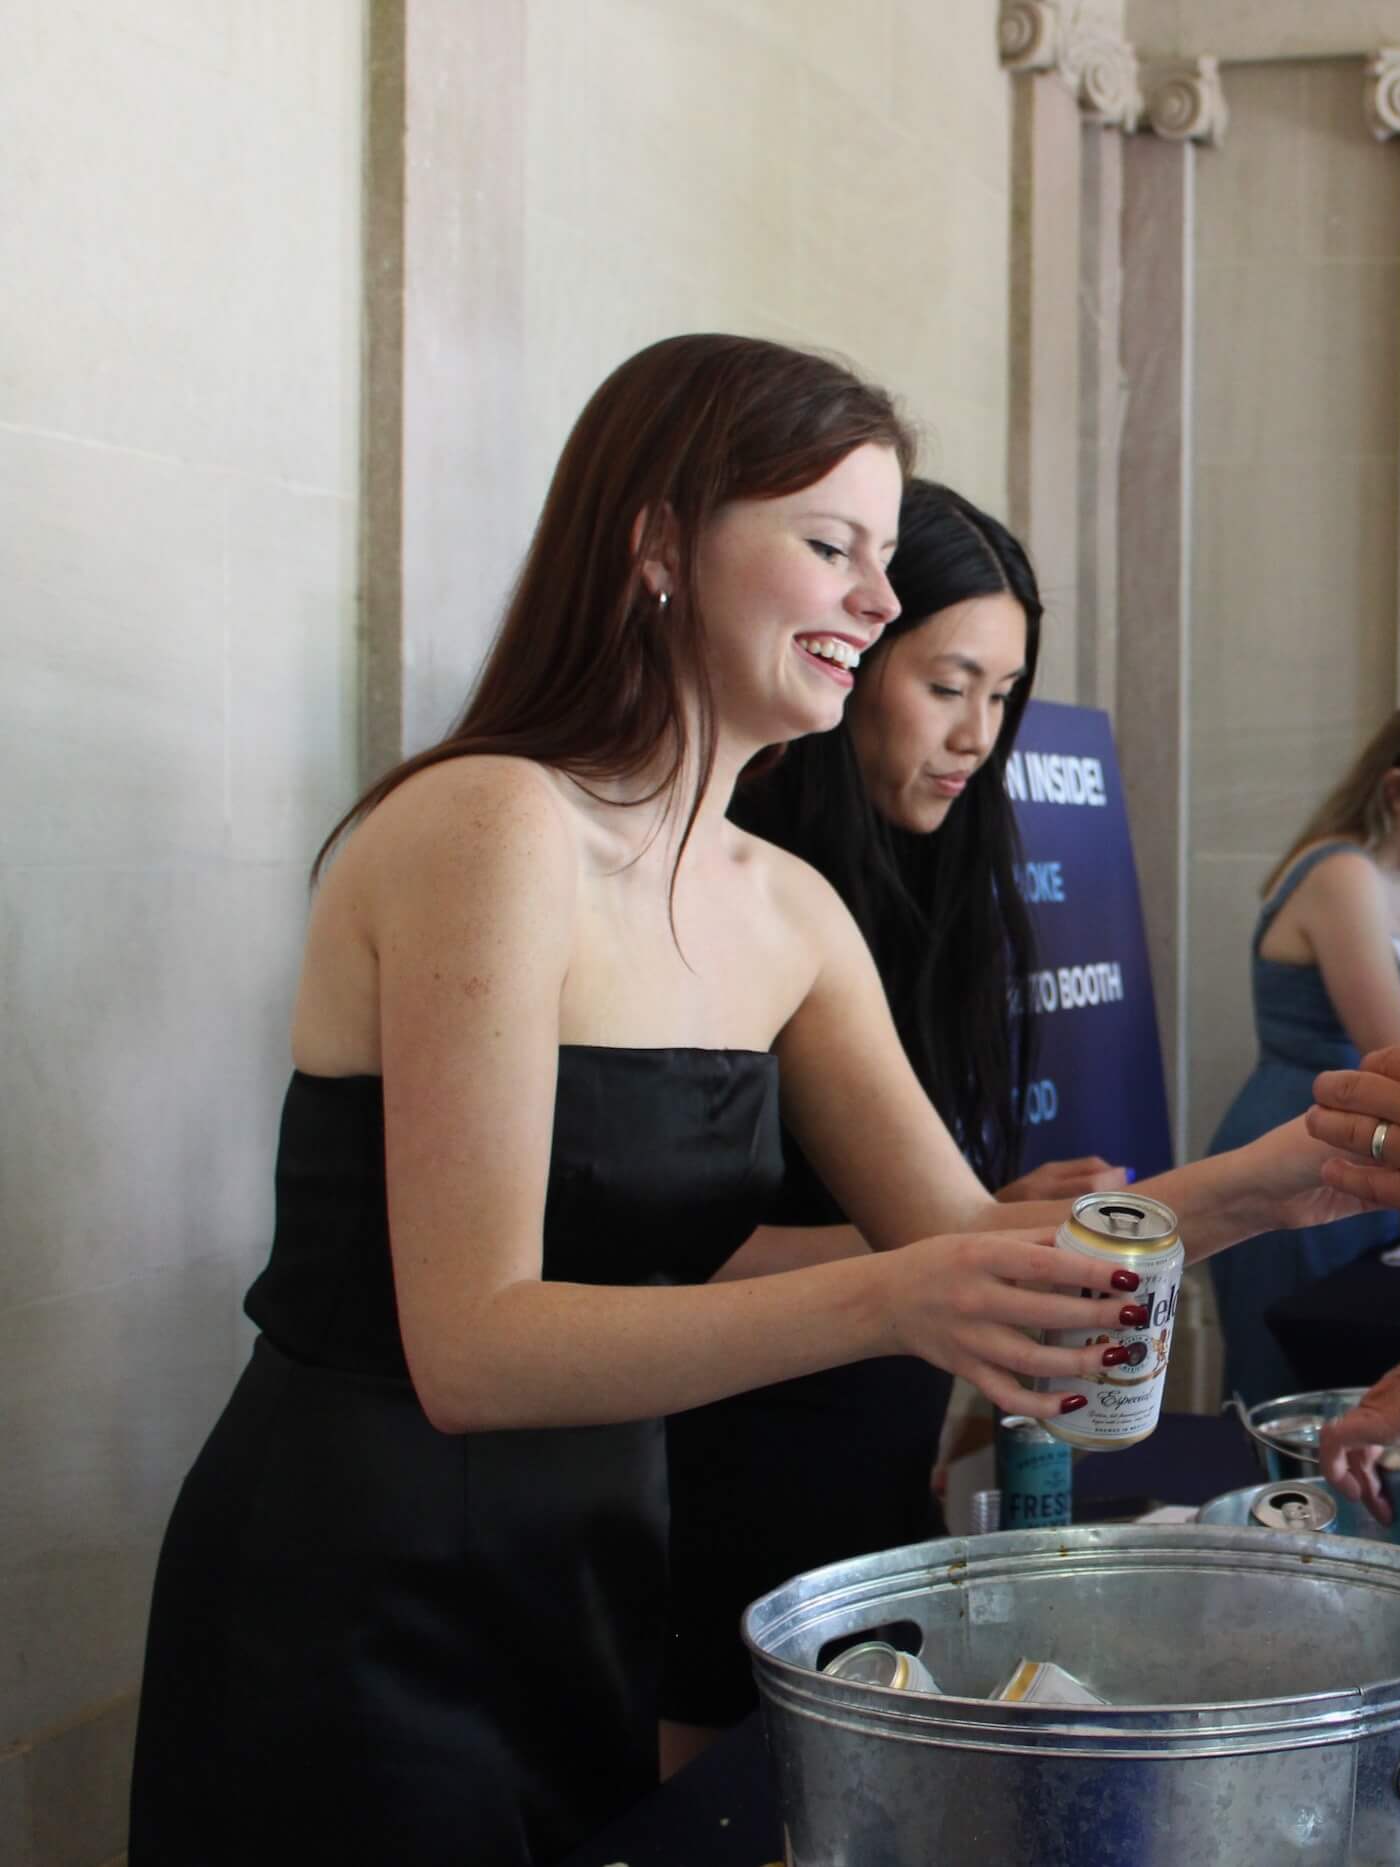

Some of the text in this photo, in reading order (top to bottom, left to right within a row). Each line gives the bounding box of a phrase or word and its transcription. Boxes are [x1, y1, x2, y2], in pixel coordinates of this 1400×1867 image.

[1004, 751, 1107, 806] N INSIDE!
[1013, 862, 1067, 902] OKE
[1057, 962, 1124, 1010] BOOTH
[1010, 1492, 1068, 1520] FRES
